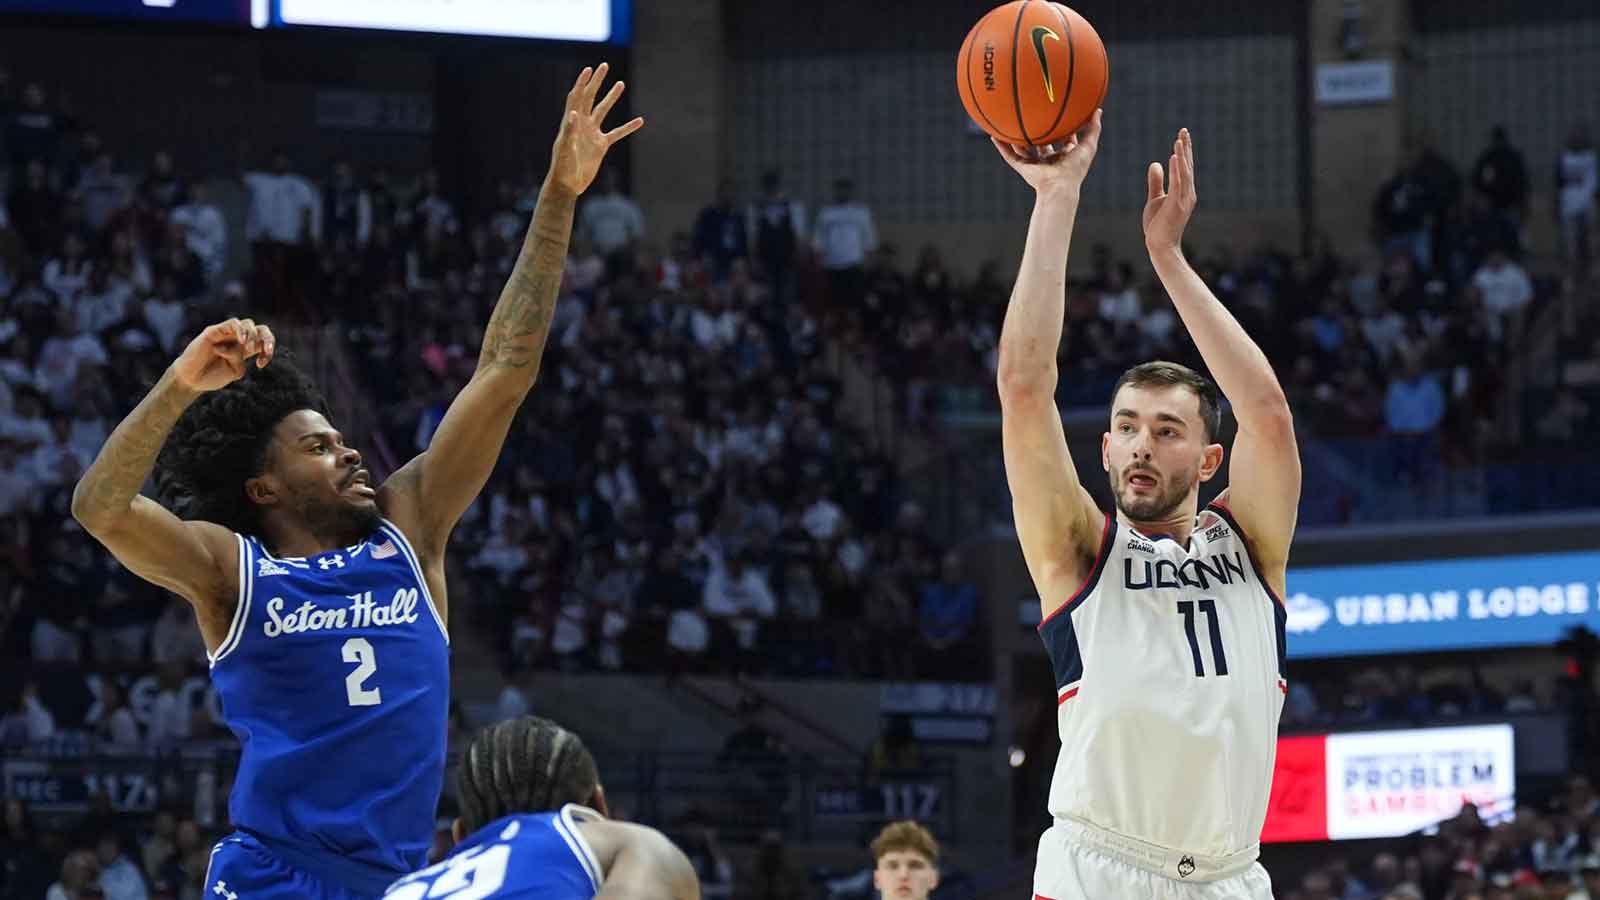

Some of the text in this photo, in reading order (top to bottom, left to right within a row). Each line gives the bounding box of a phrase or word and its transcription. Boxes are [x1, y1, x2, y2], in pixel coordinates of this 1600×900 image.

[1205, 525, 1222, 536] BIG
[1206, 528, 1229, 540] EAST
[1124, 551, 1247, 591] UCONN
[263, 587, 419, 638] Seton Hall
[1336, 590, 1458, 625] URBAN
[1468, 583, 1588, 617] LODGE
[1177, 599, 1228, 677] 11
[340, 637, 381, 706] 2
[1344, 764, 1494, 788] PROBLEM
[881, 783, 940, 817] 117
